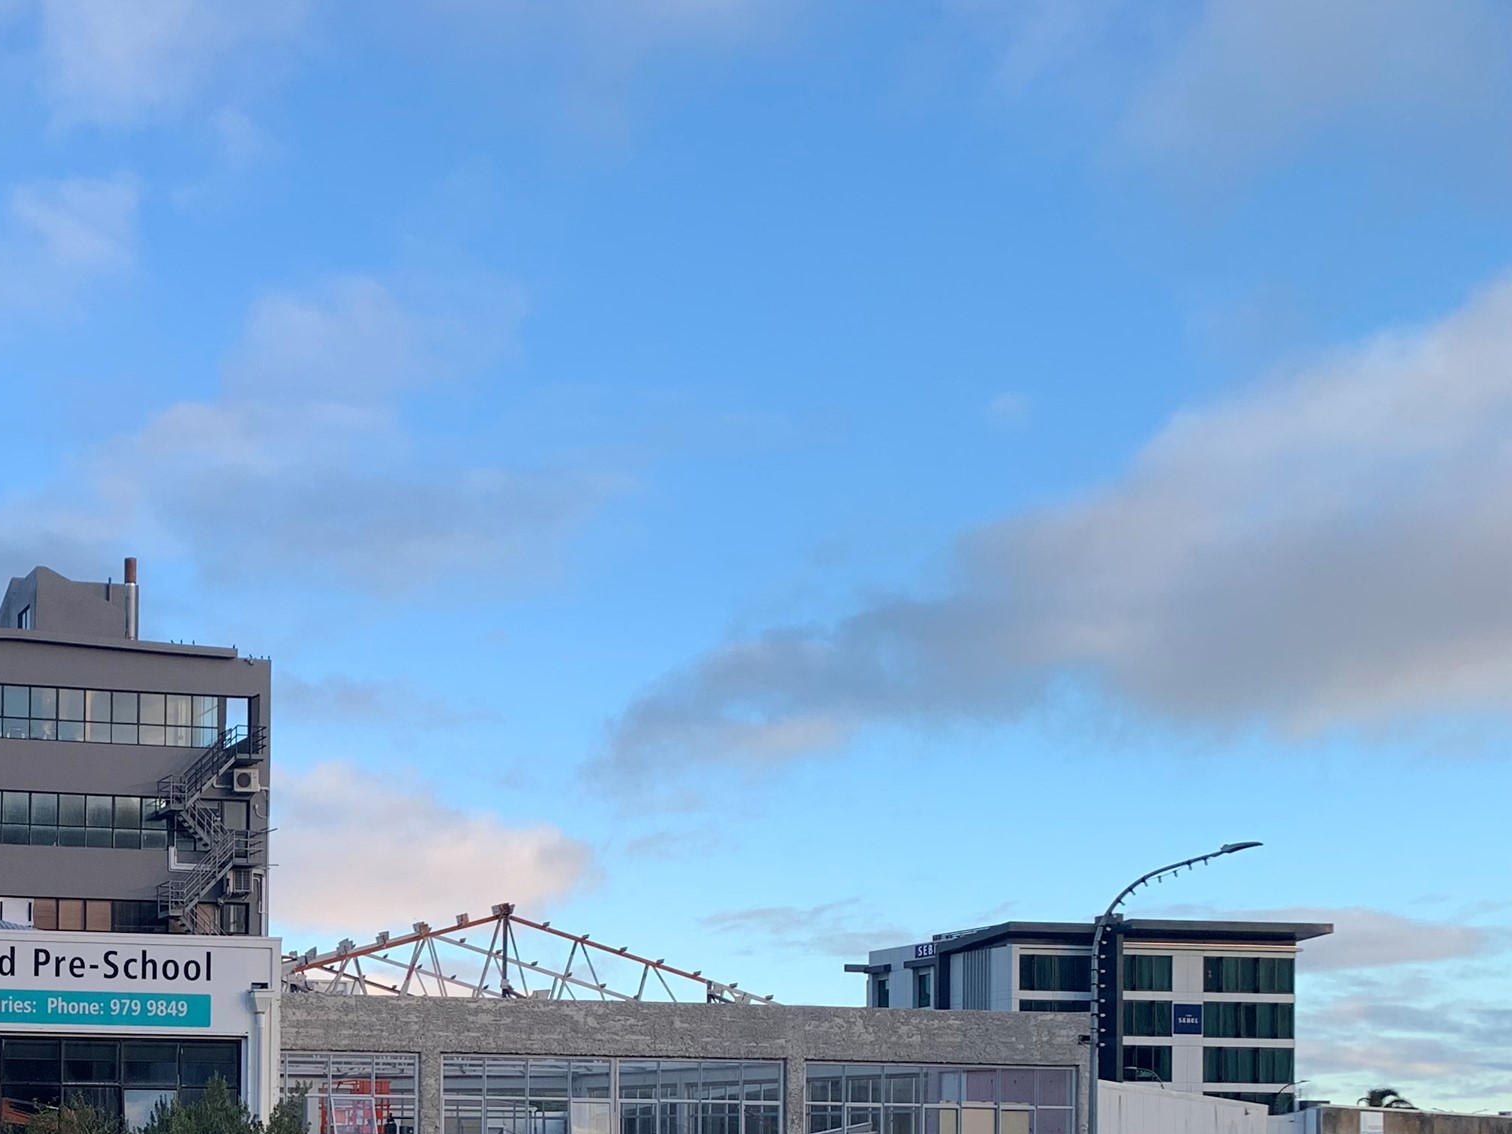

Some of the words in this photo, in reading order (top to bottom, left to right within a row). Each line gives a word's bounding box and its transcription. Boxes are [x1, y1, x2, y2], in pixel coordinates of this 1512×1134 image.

[33, 948, 212, 981] Pre-School
[47, 997, 104, 1015] Phone:
[110, 999, 141, 1016] 979
[146, 1000, 188, 1017] 9849
